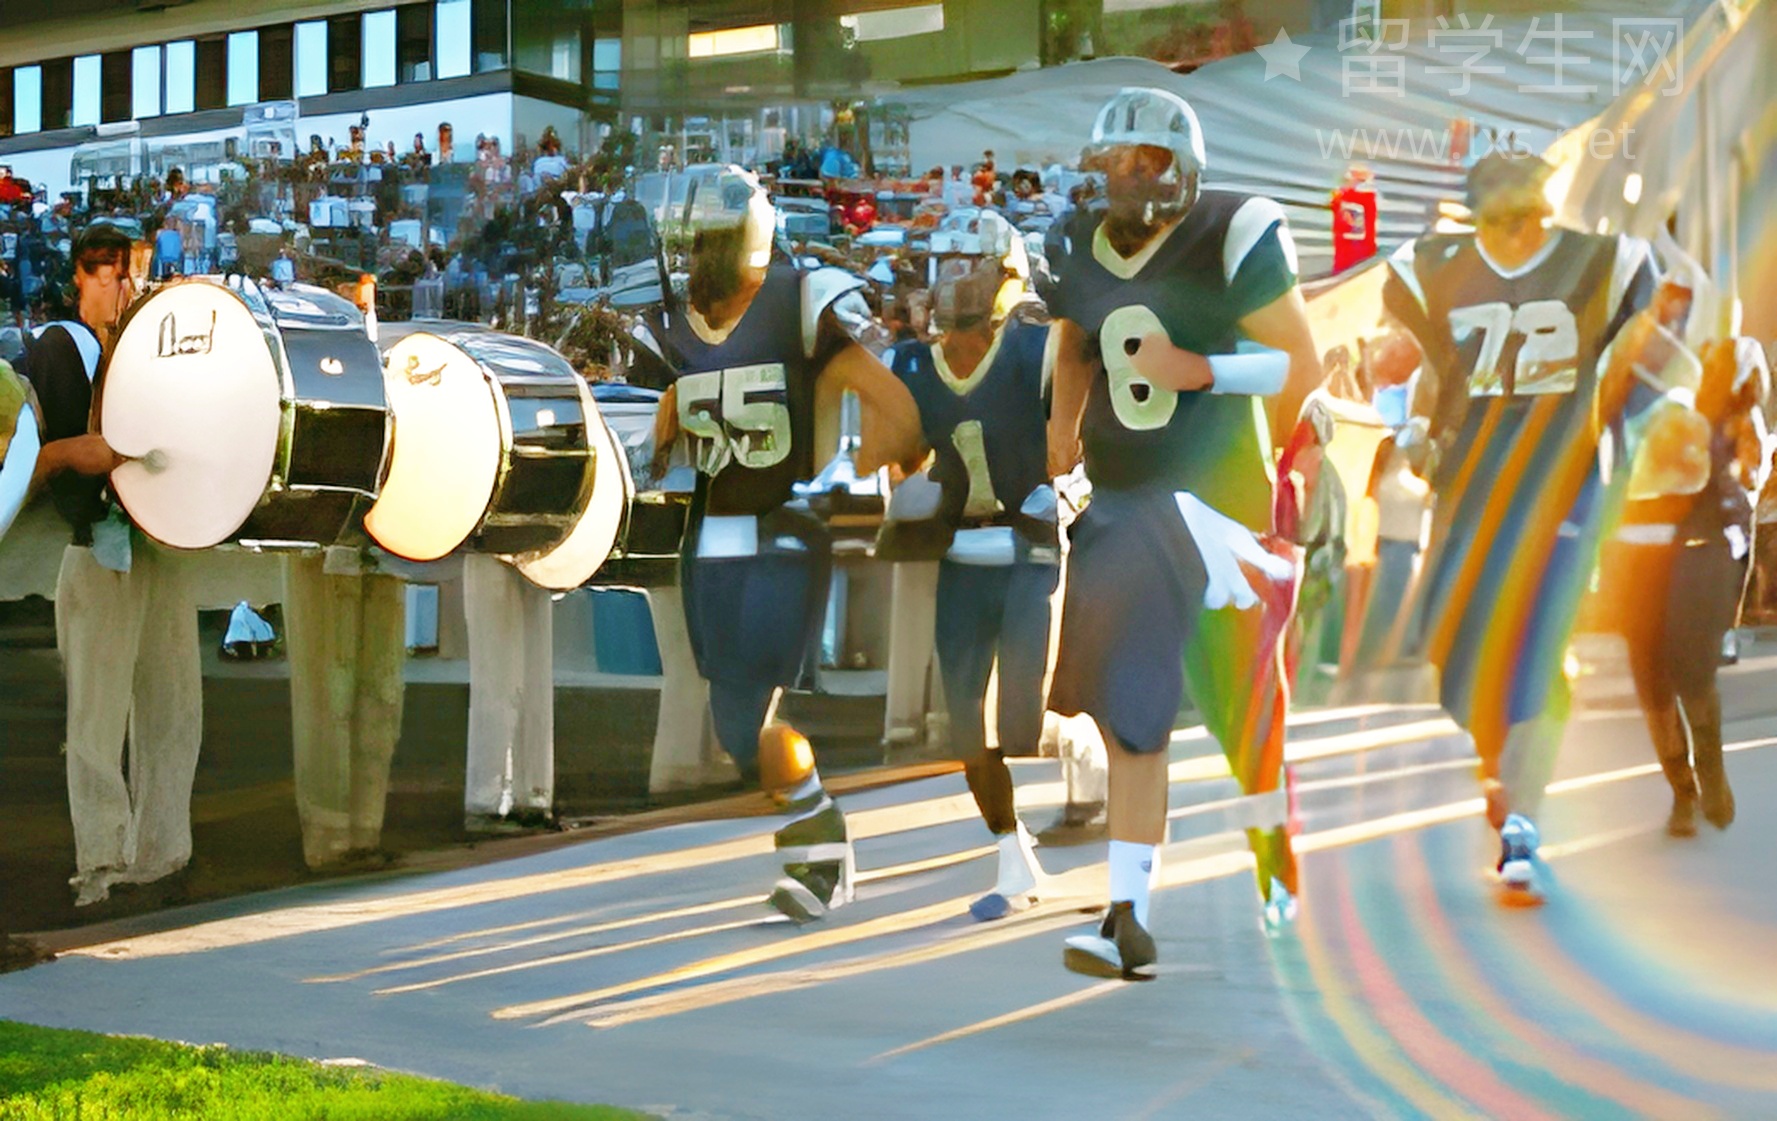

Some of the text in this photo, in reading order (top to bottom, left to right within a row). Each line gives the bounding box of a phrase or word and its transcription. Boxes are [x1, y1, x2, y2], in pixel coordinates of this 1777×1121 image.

[1099, 304, 1178, 430] 8
[1448, 299, 1579, 398] 72
[676, 362, 792, 477] 55
